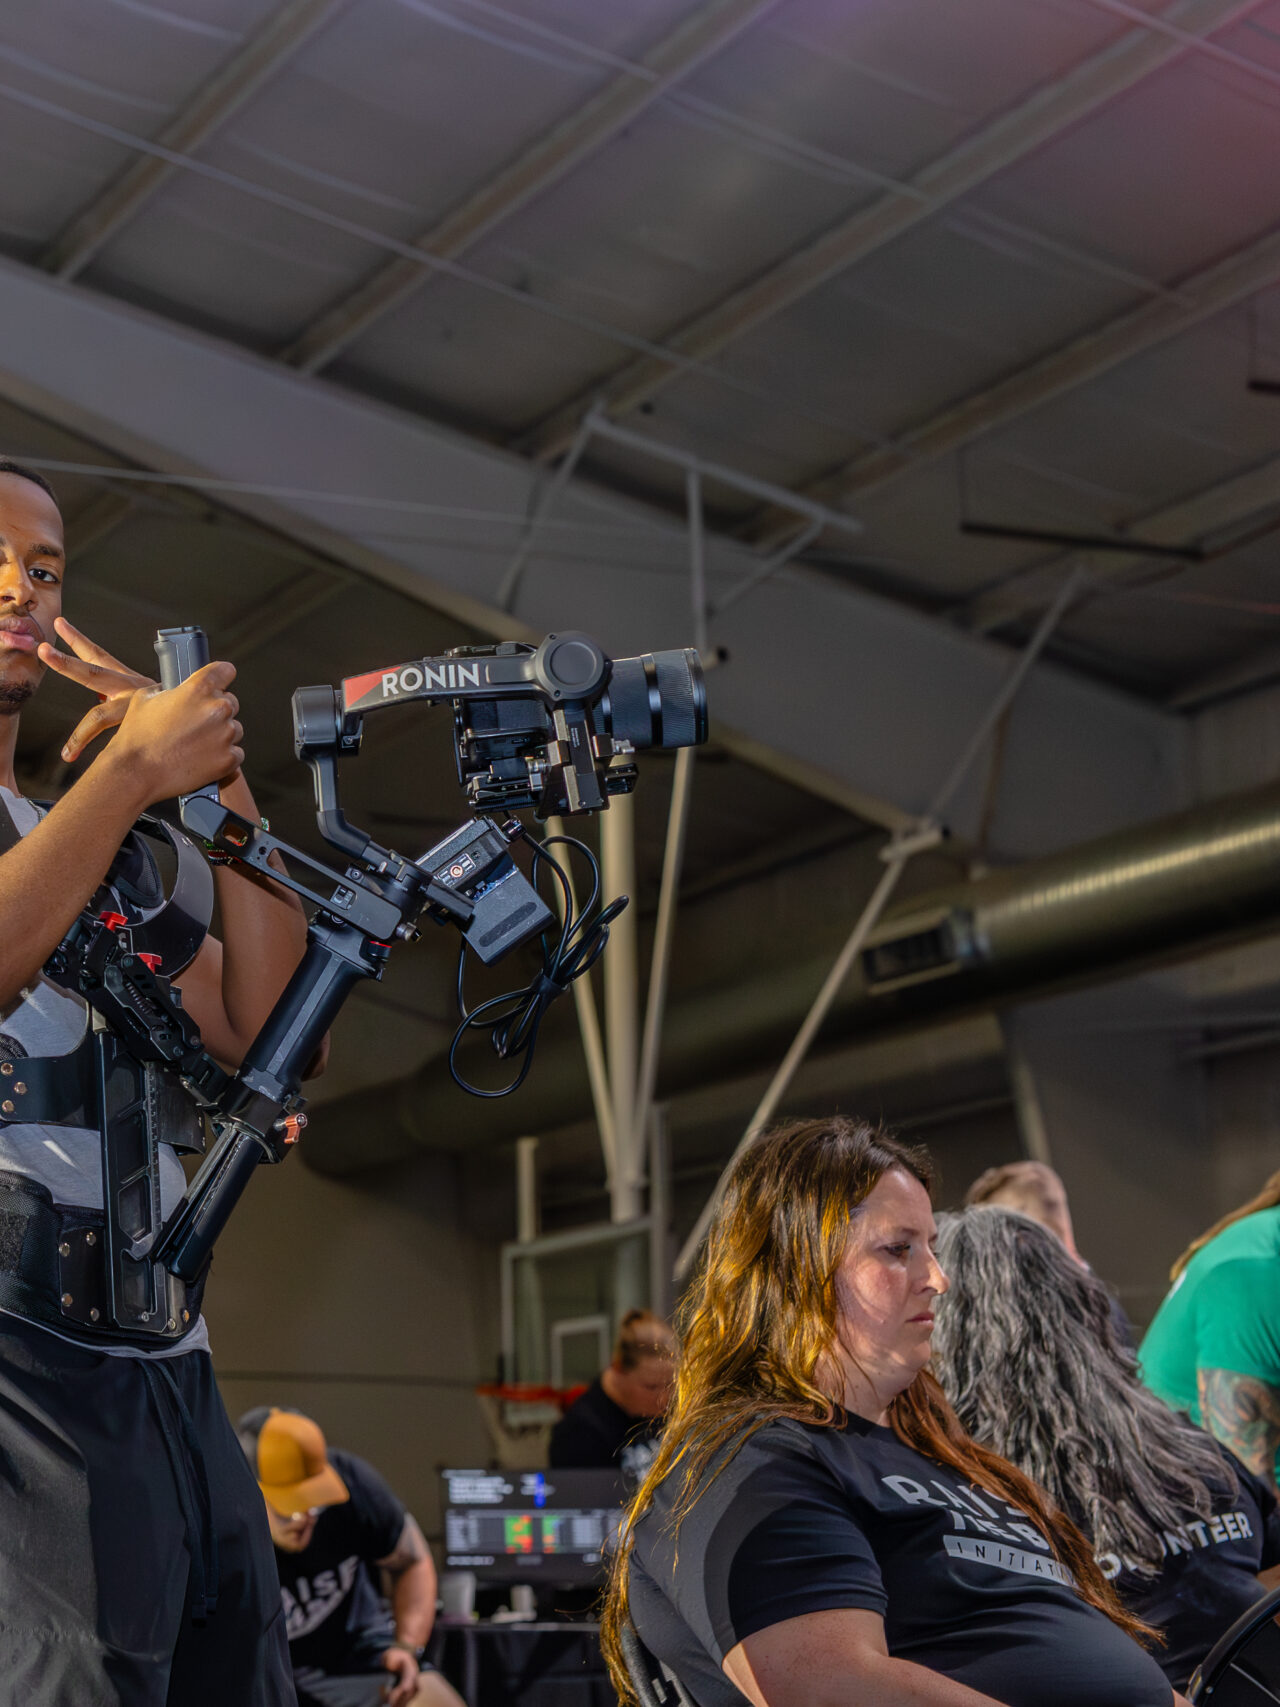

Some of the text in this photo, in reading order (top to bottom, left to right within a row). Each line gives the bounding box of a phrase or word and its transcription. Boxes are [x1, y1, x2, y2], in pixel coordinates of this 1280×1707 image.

[381, 663, 480, 698] RONIN
[881, 1475, 1031, 1519] RAI
[956, 1541, 1077, 1587] INITIAT
